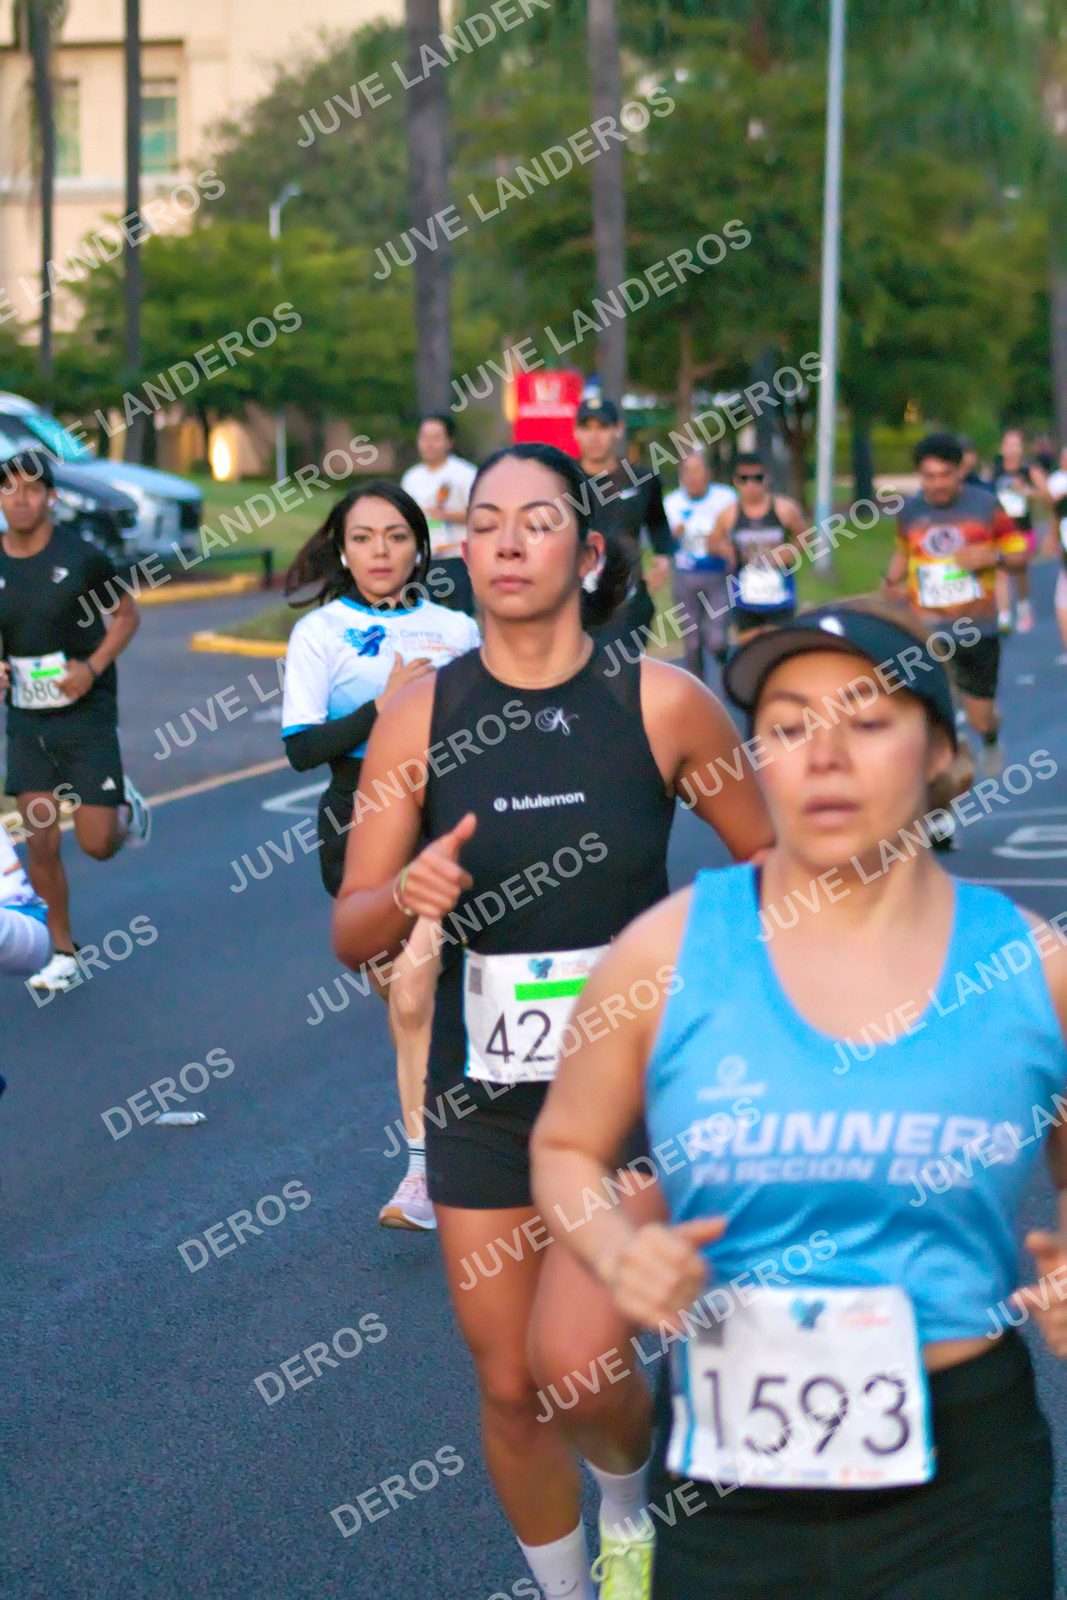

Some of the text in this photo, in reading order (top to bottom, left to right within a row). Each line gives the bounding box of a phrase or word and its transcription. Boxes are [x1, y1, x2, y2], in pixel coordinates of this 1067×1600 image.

[511, 791, 585, 812] lululemon
[486, 1009, 555, 1064] 42
[690, 1110, 1023, 1166] RUNNERS
[704, 1369, 910, 1456] 1593
